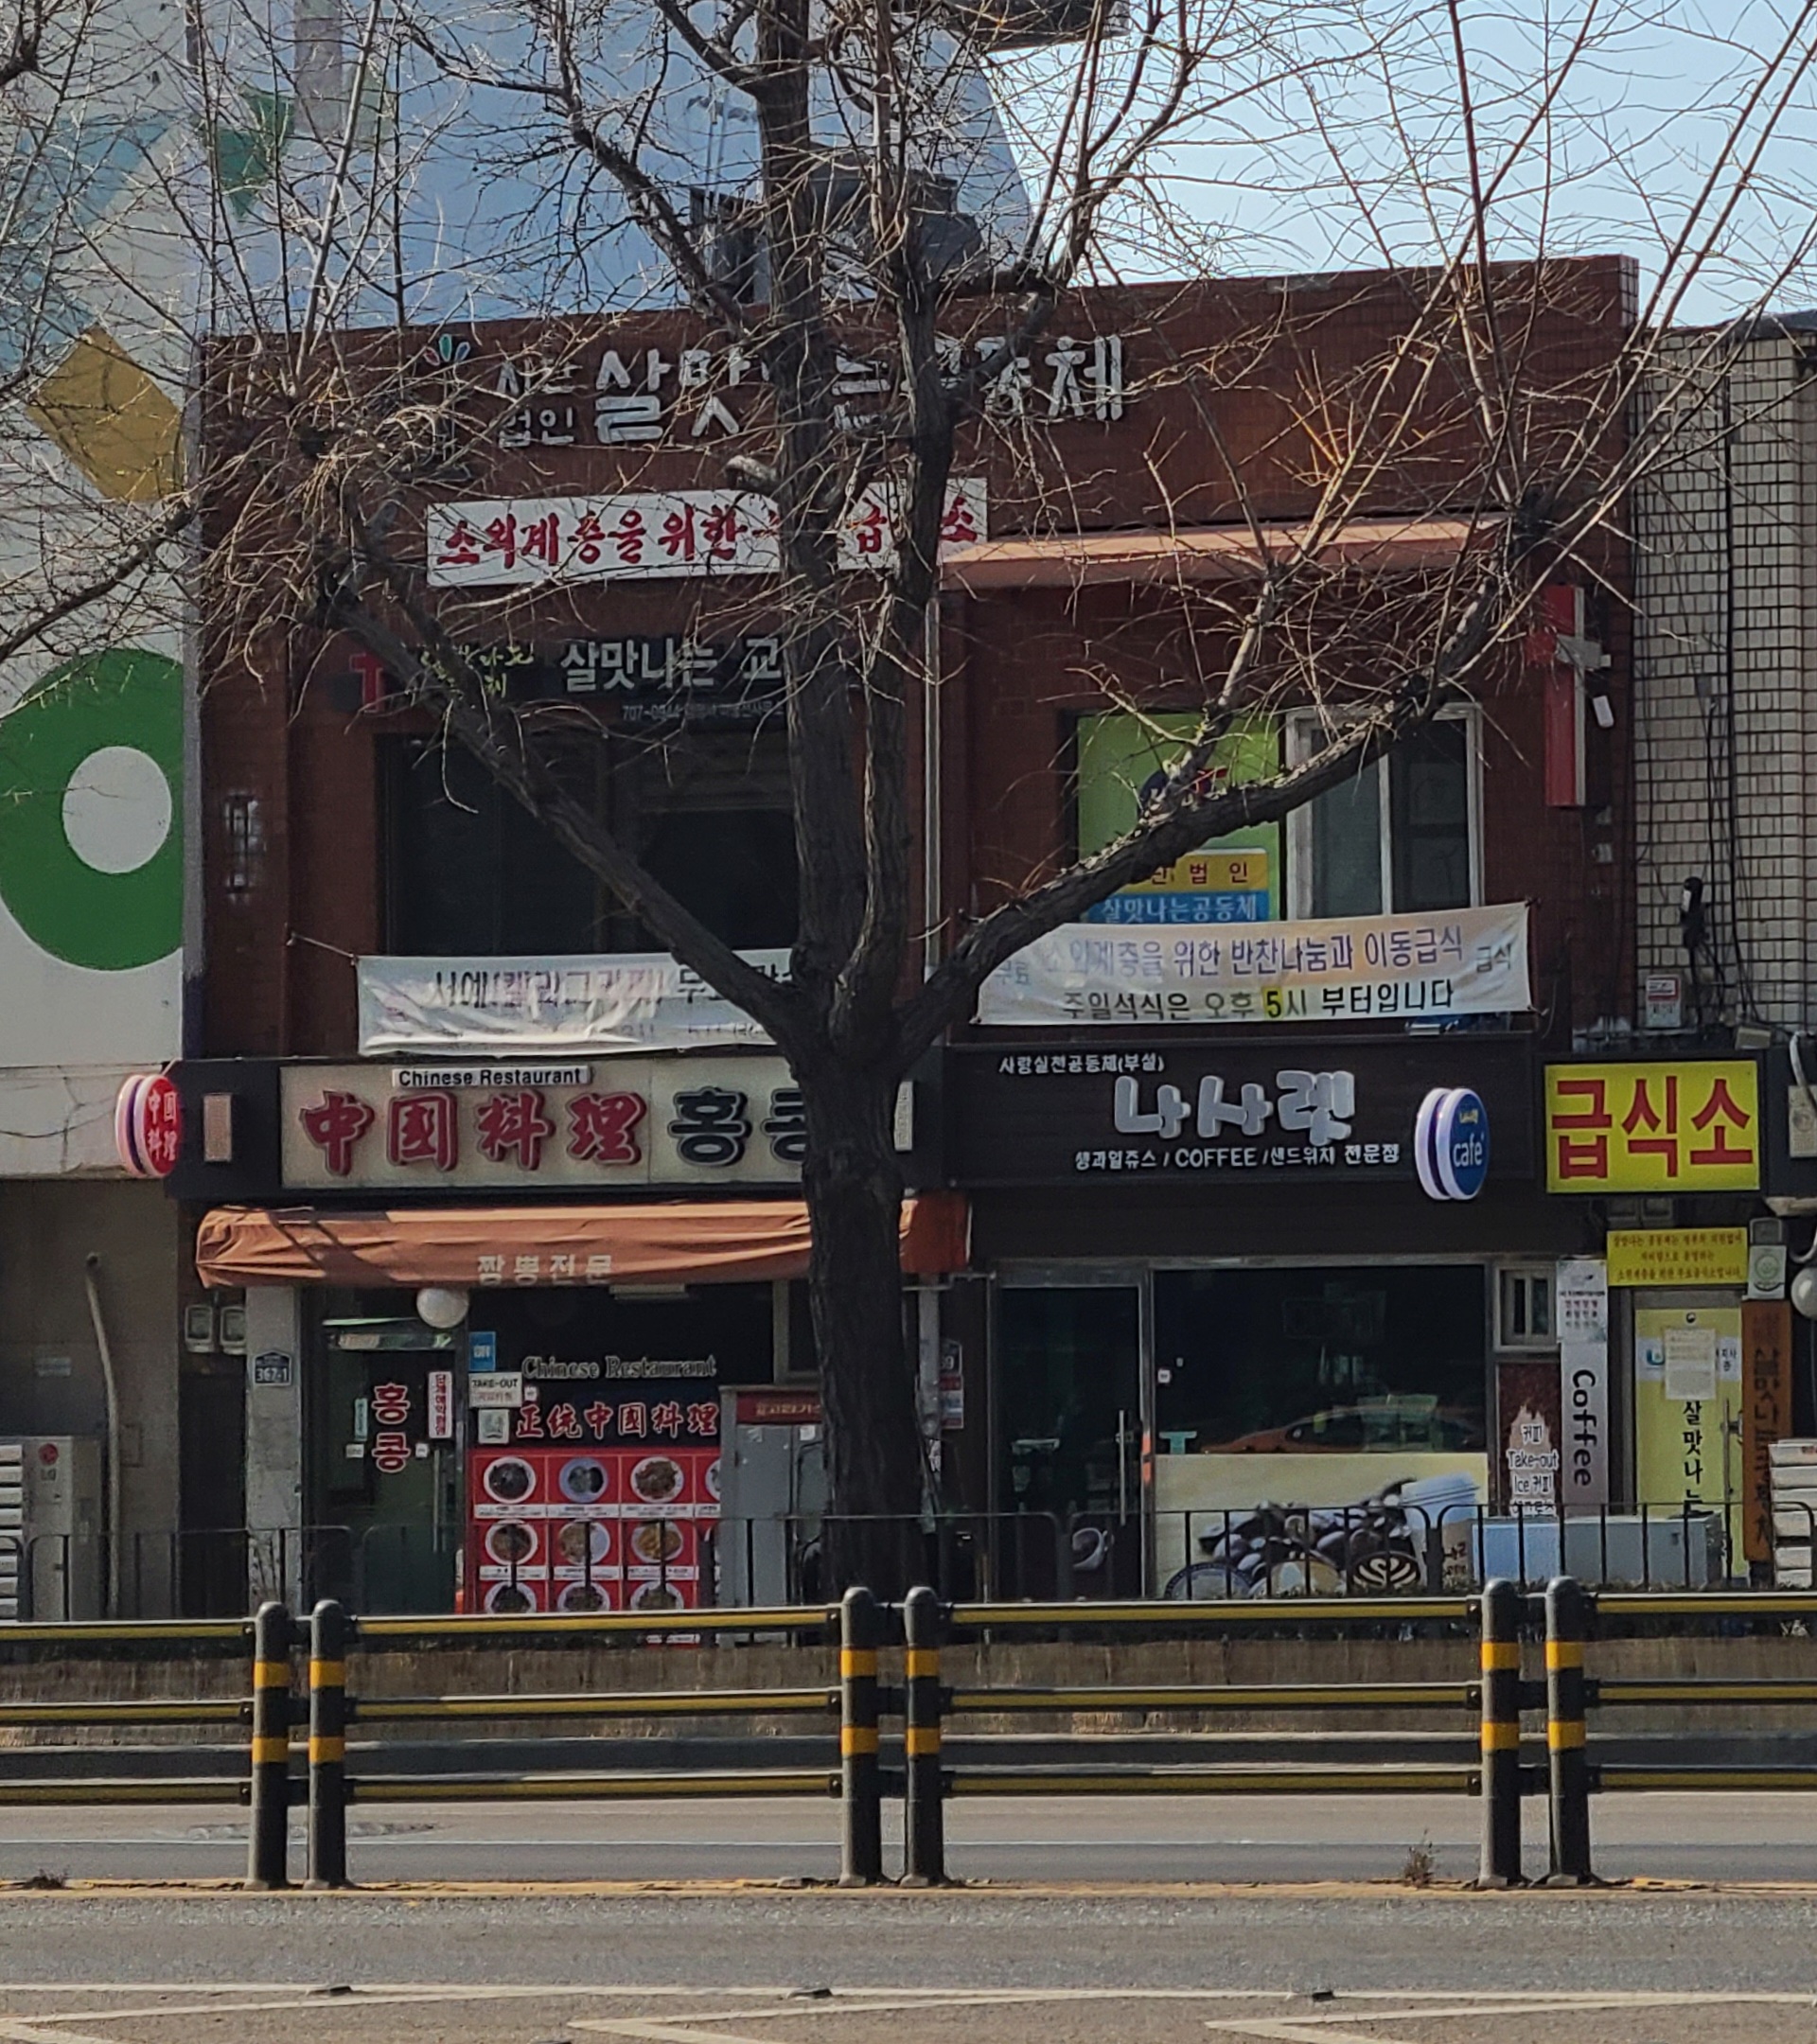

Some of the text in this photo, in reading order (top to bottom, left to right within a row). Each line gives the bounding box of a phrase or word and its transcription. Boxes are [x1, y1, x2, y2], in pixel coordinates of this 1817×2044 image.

[560, 638, 717, 692] 살맛나는
[1174, 940, 1221, 978] 위한
[1231, 932, 1353, 977] 반찬나눔과
[1364, 924, 1464, 970] 이동급식
[1204, 992, 1256, 1020] 오후
[1321, 978, 1455, 1017] 부터입니다
[397, 1065, 581, 1086] Chinese Restaurant
[1114, 1069, 1356, 1147] 나사렛
[1551, 1075, 1754, 1179] 급식소
[1174, 1147, 1258, 1168] COFFEE
[1344, 1142, 1400, 1165] 전문점
[521, 1354, 717, 1379] Chinese Restaurant
[371, 1382, 412, 1473] 홍콩
[1572, 1369, 1597, 1487] Coffee
[1508, 1450, 1558, 1469] Take-out
[1514, 1474, 1529, 1493] Ice
